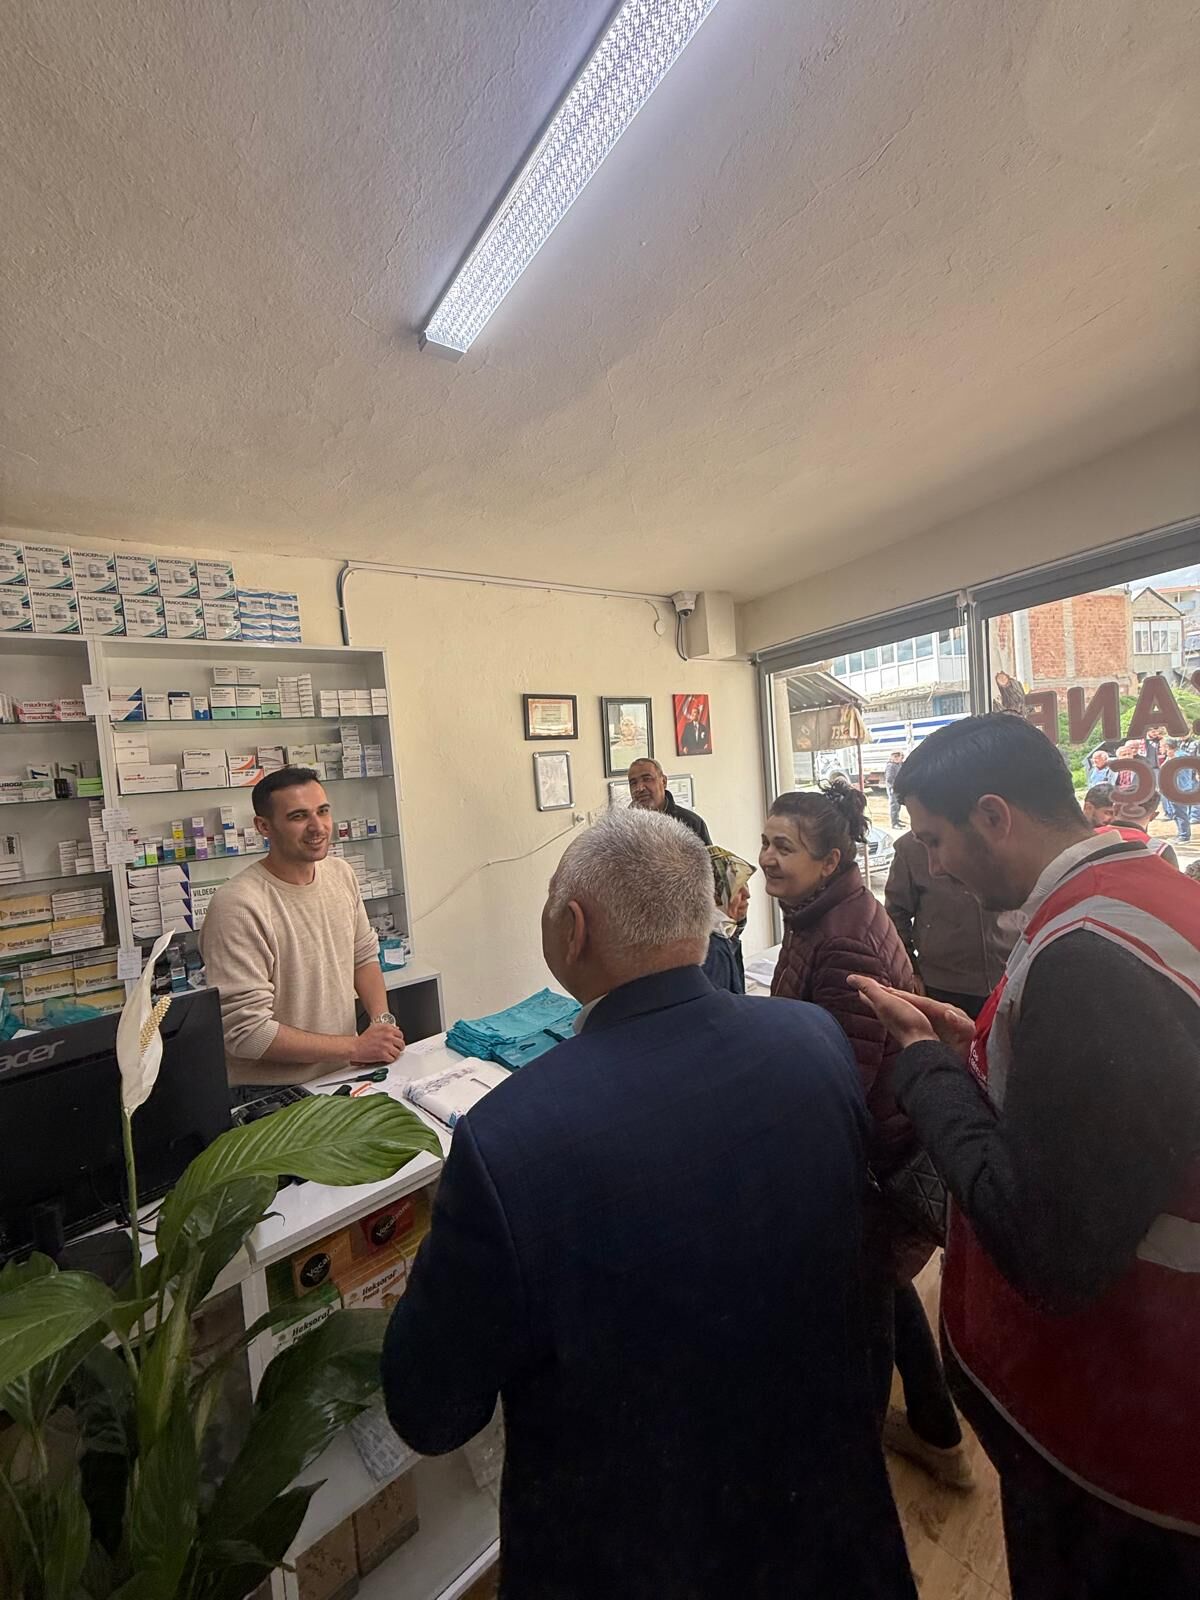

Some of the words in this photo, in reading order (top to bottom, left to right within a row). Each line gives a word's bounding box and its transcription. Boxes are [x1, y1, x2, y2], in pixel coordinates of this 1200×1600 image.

[0, 1040, 65, 1072] acer
[362, 1269, 398, 1296] Heksoral
[292, 1308, 330, 1337] Heksoral
